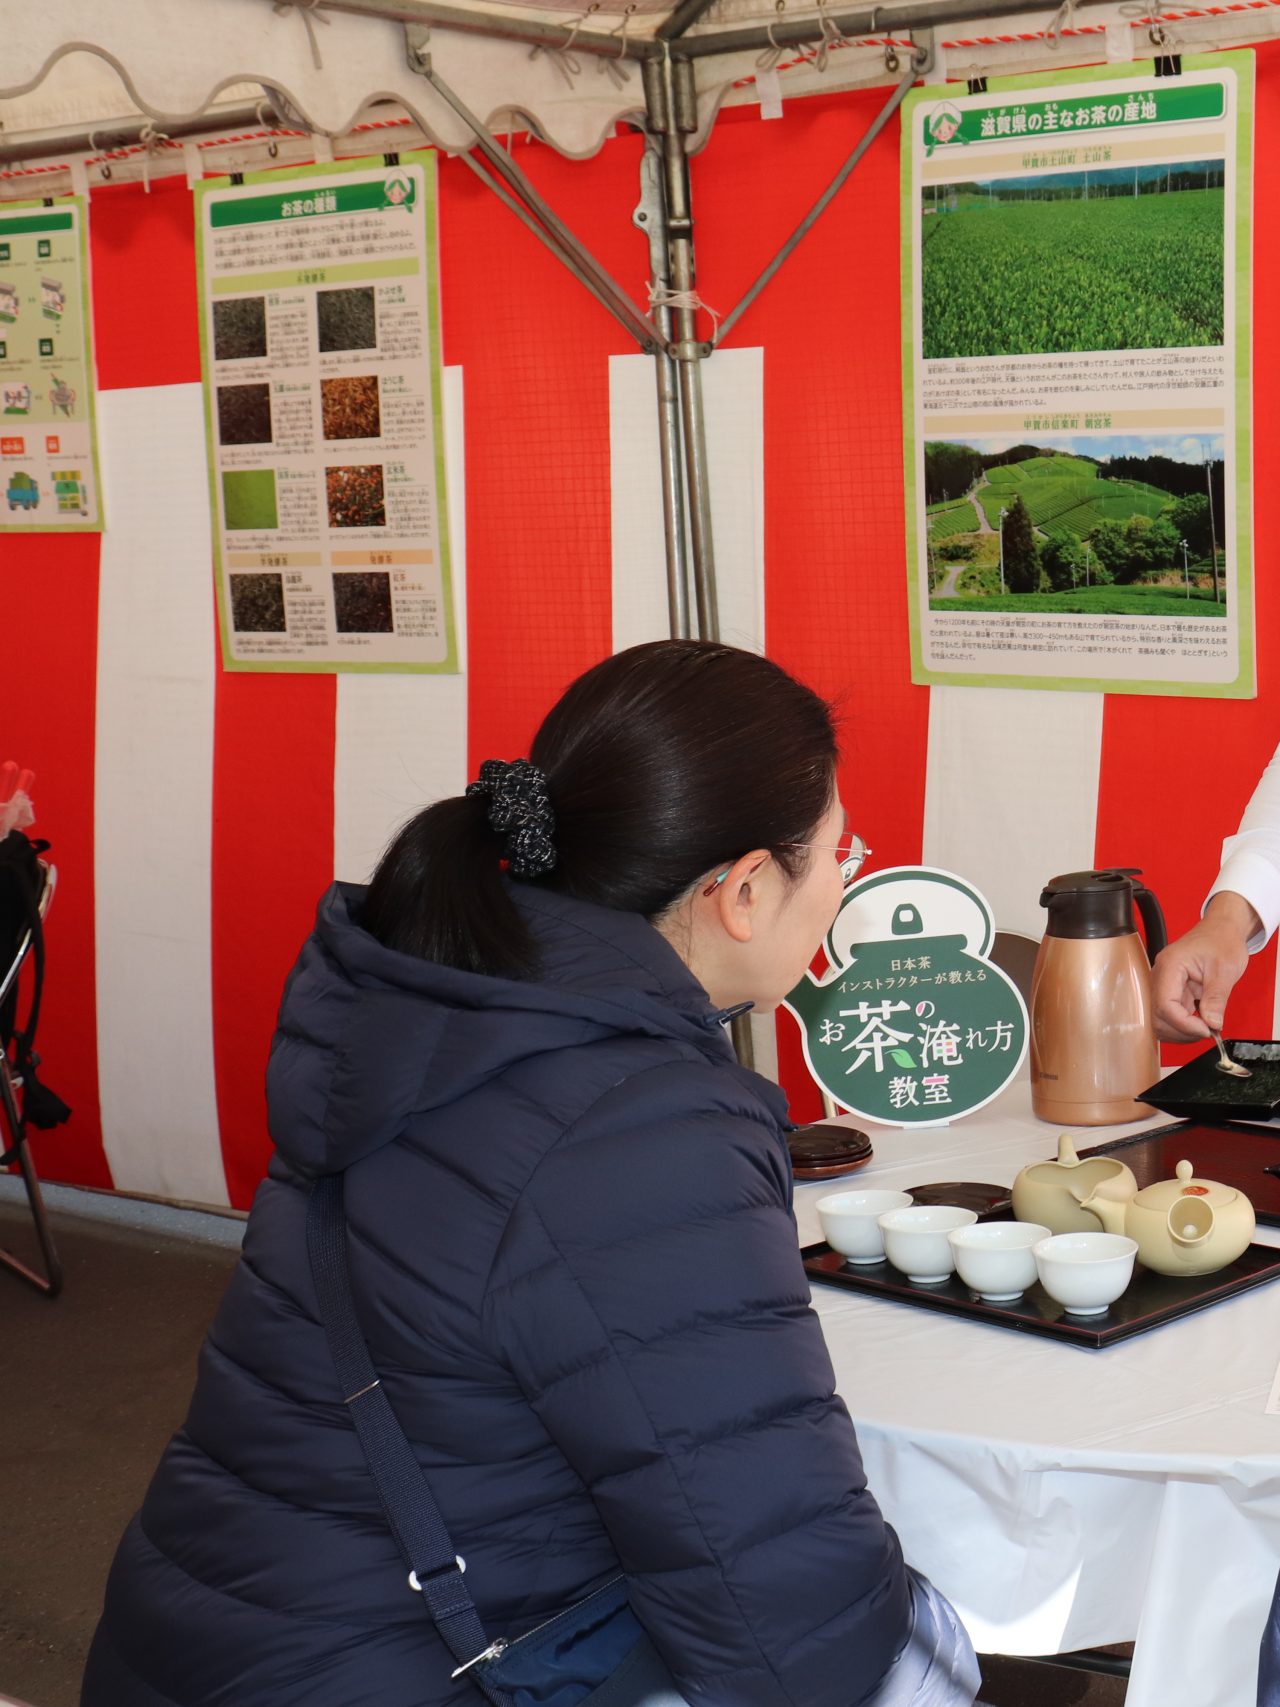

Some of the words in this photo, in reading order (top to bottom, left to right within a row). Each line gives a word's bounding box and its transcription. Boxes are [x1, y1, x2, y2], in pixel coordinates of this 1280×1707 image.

[980, 102, 1157, 137] 滋賀県の主なお茶の産地
[281, 195, 337, 218] お茶の種類
[890, 956, 932, 972] 日本茶
[837, 968, 988, 994] インストラクターが教える
[818, 999, 1015, 1075] お茶の淹れ方
[888, 1074, 953, 1109] 教室
